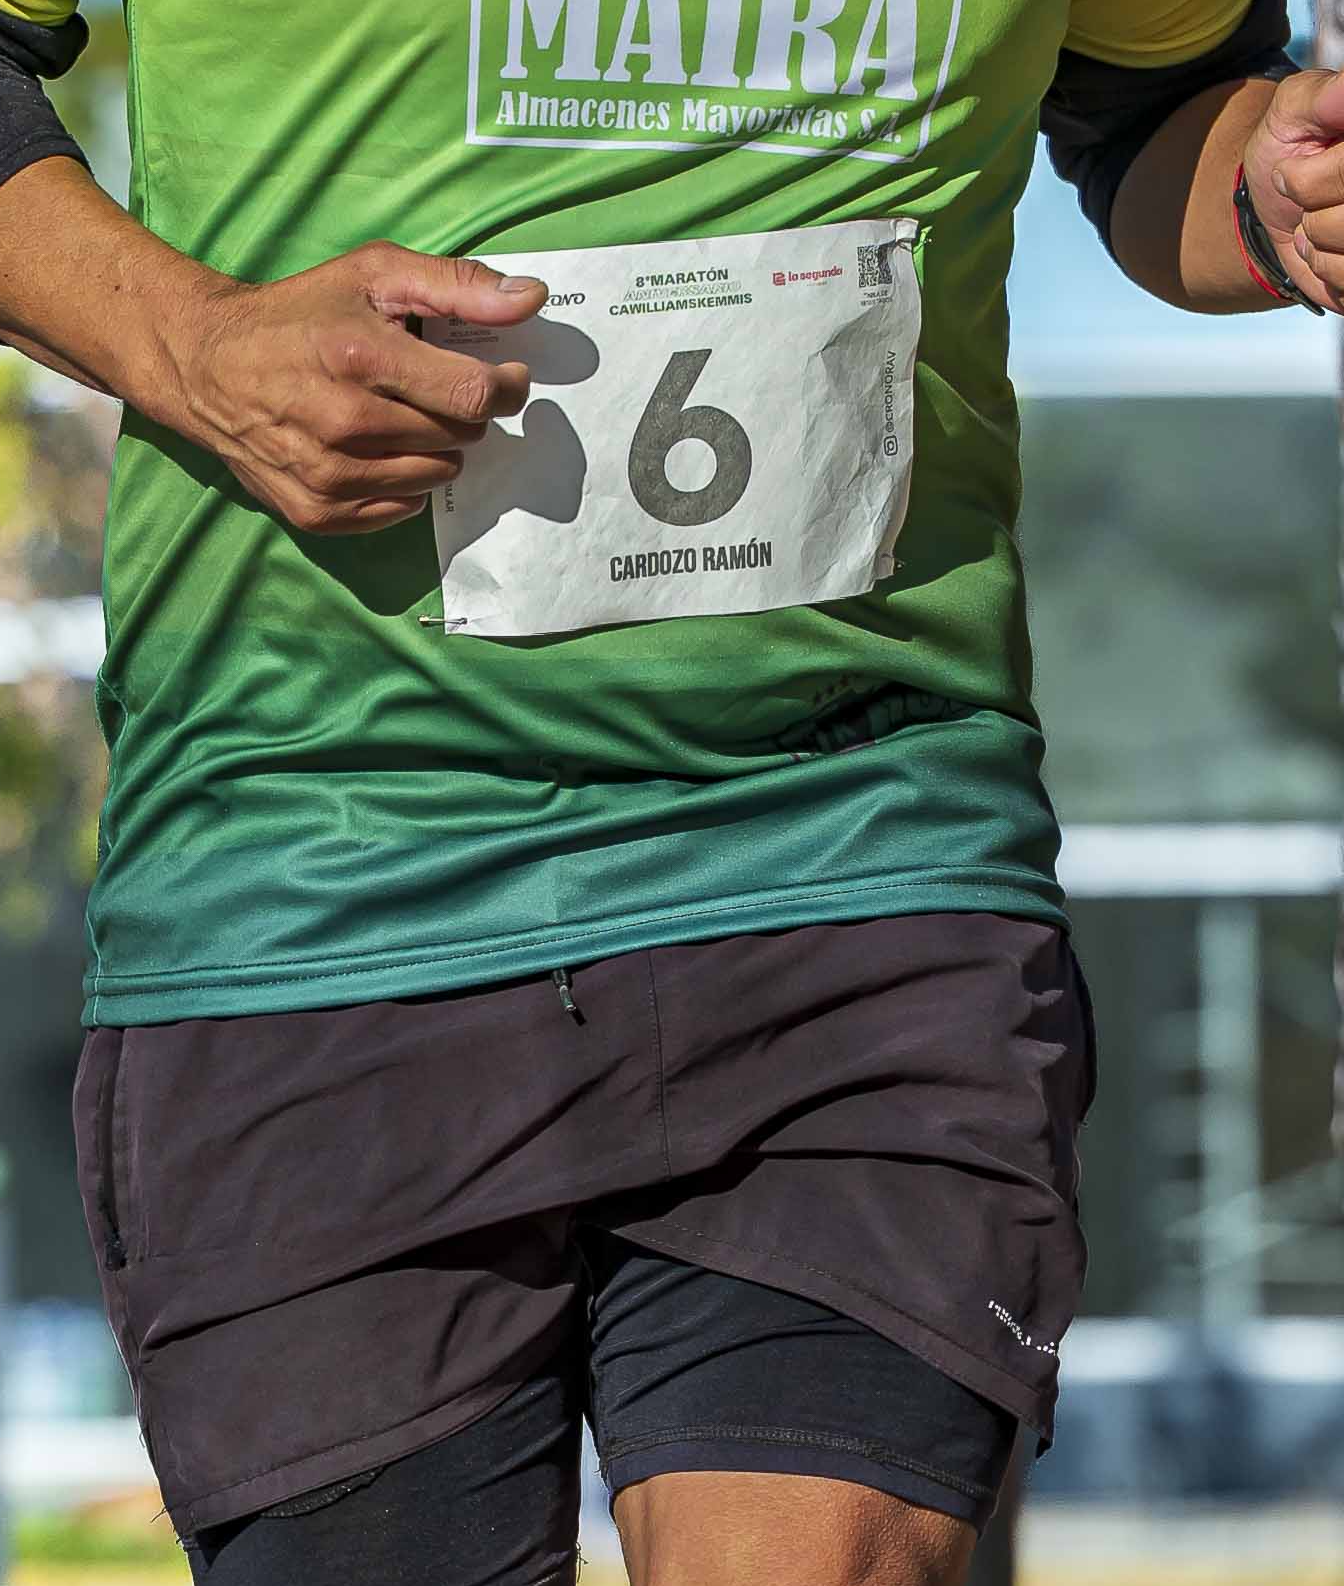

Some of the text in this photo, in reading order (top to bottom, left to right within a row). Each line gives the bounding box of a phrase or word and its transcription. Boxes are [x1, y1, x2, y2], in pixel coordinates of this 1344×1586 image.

[495, 90, 671, 132] Almacenes
[681, 97, 848, 140] Mayoristas
[799, 265, 844, 282] segunda
[608, 293, 753, 317] CAWILLIAMSKEMMIS
[884, 350, 897, 434] @CRONORAV
[627, 348, 753, 527] 6
[609, 537, 774, 583] CARDOZO RAMÓN
